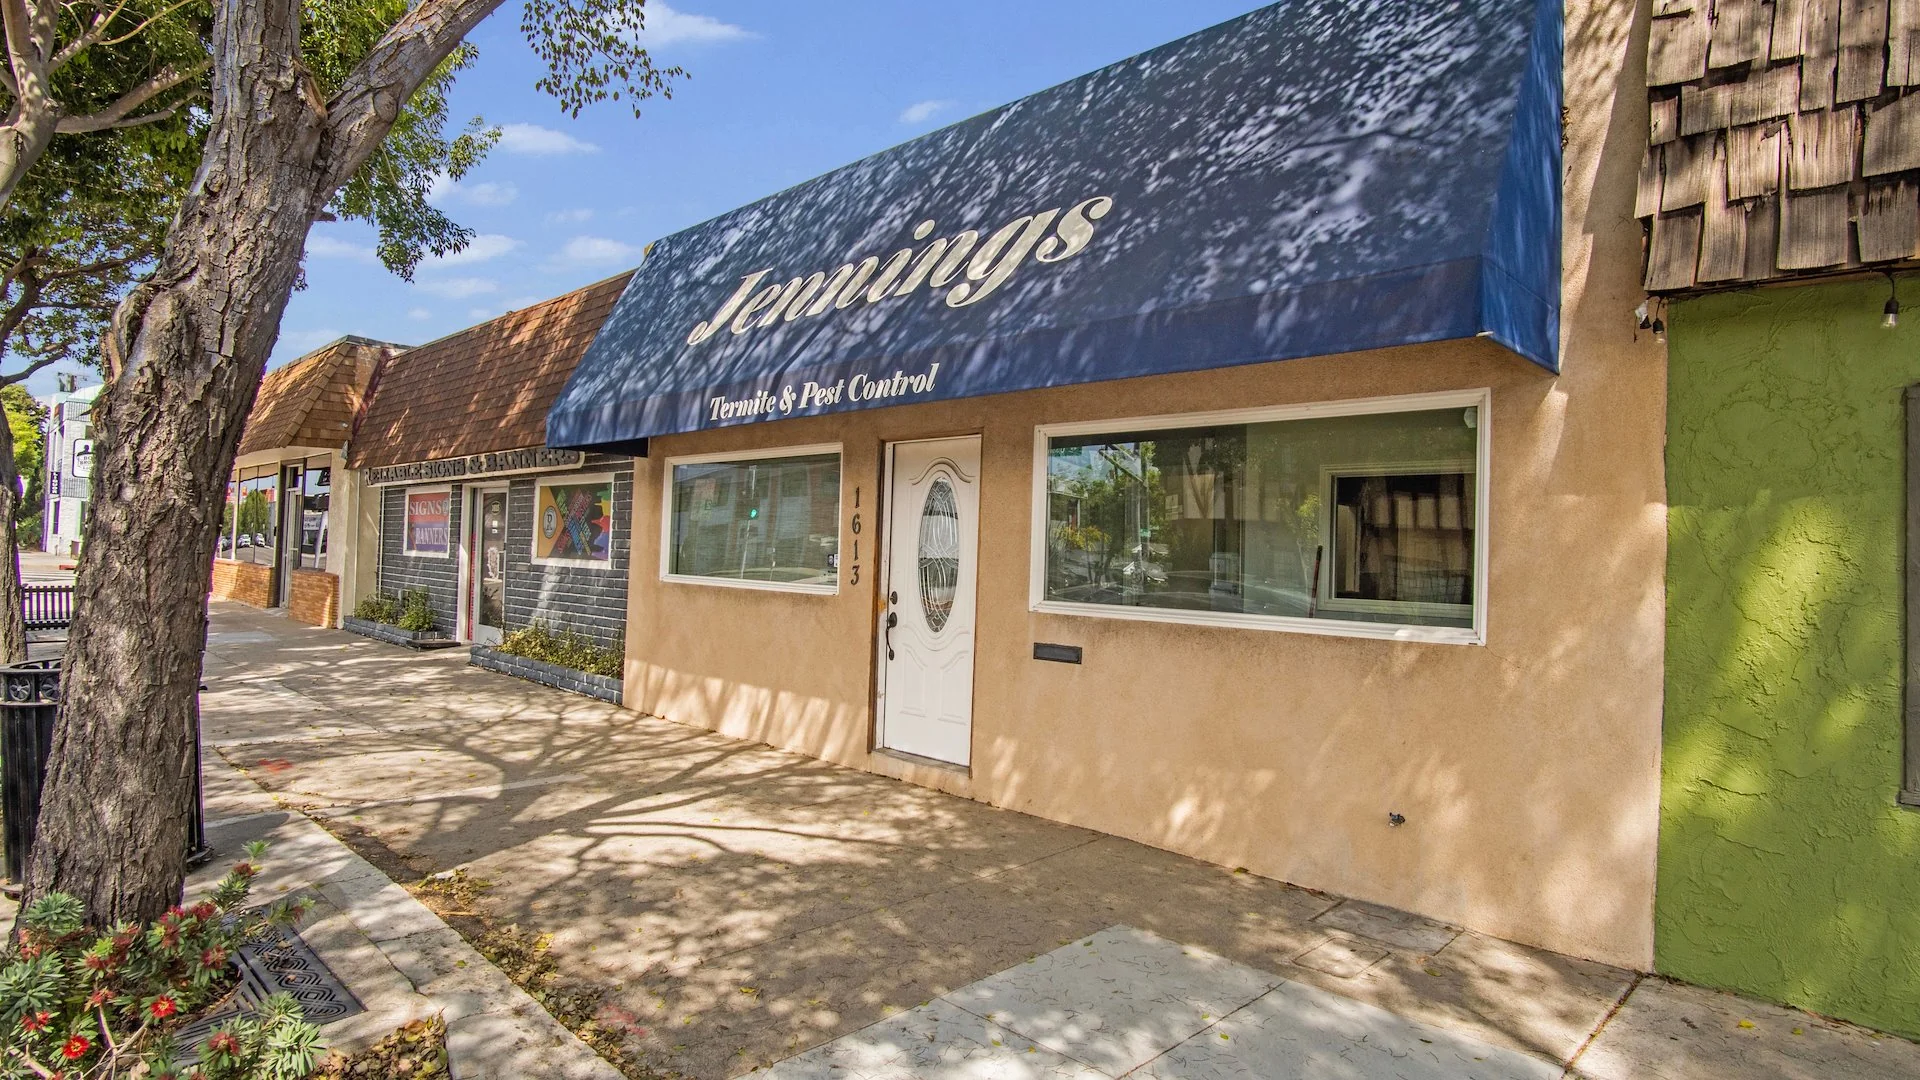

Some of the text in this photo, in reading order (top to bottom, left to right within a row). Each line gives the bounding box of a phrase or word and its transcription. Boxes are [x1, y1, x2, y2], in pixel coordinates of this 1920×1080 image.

[687, 196, 1114, 347] Jennings
[709, 362, 940, 421] Termite & Pest Control
[364, 449, 580, 485] RELIABLE SIGNS & BANNERS
[409, 500, 442, 516] SIGNS
[415, 527, 448, 545] BANNERS
